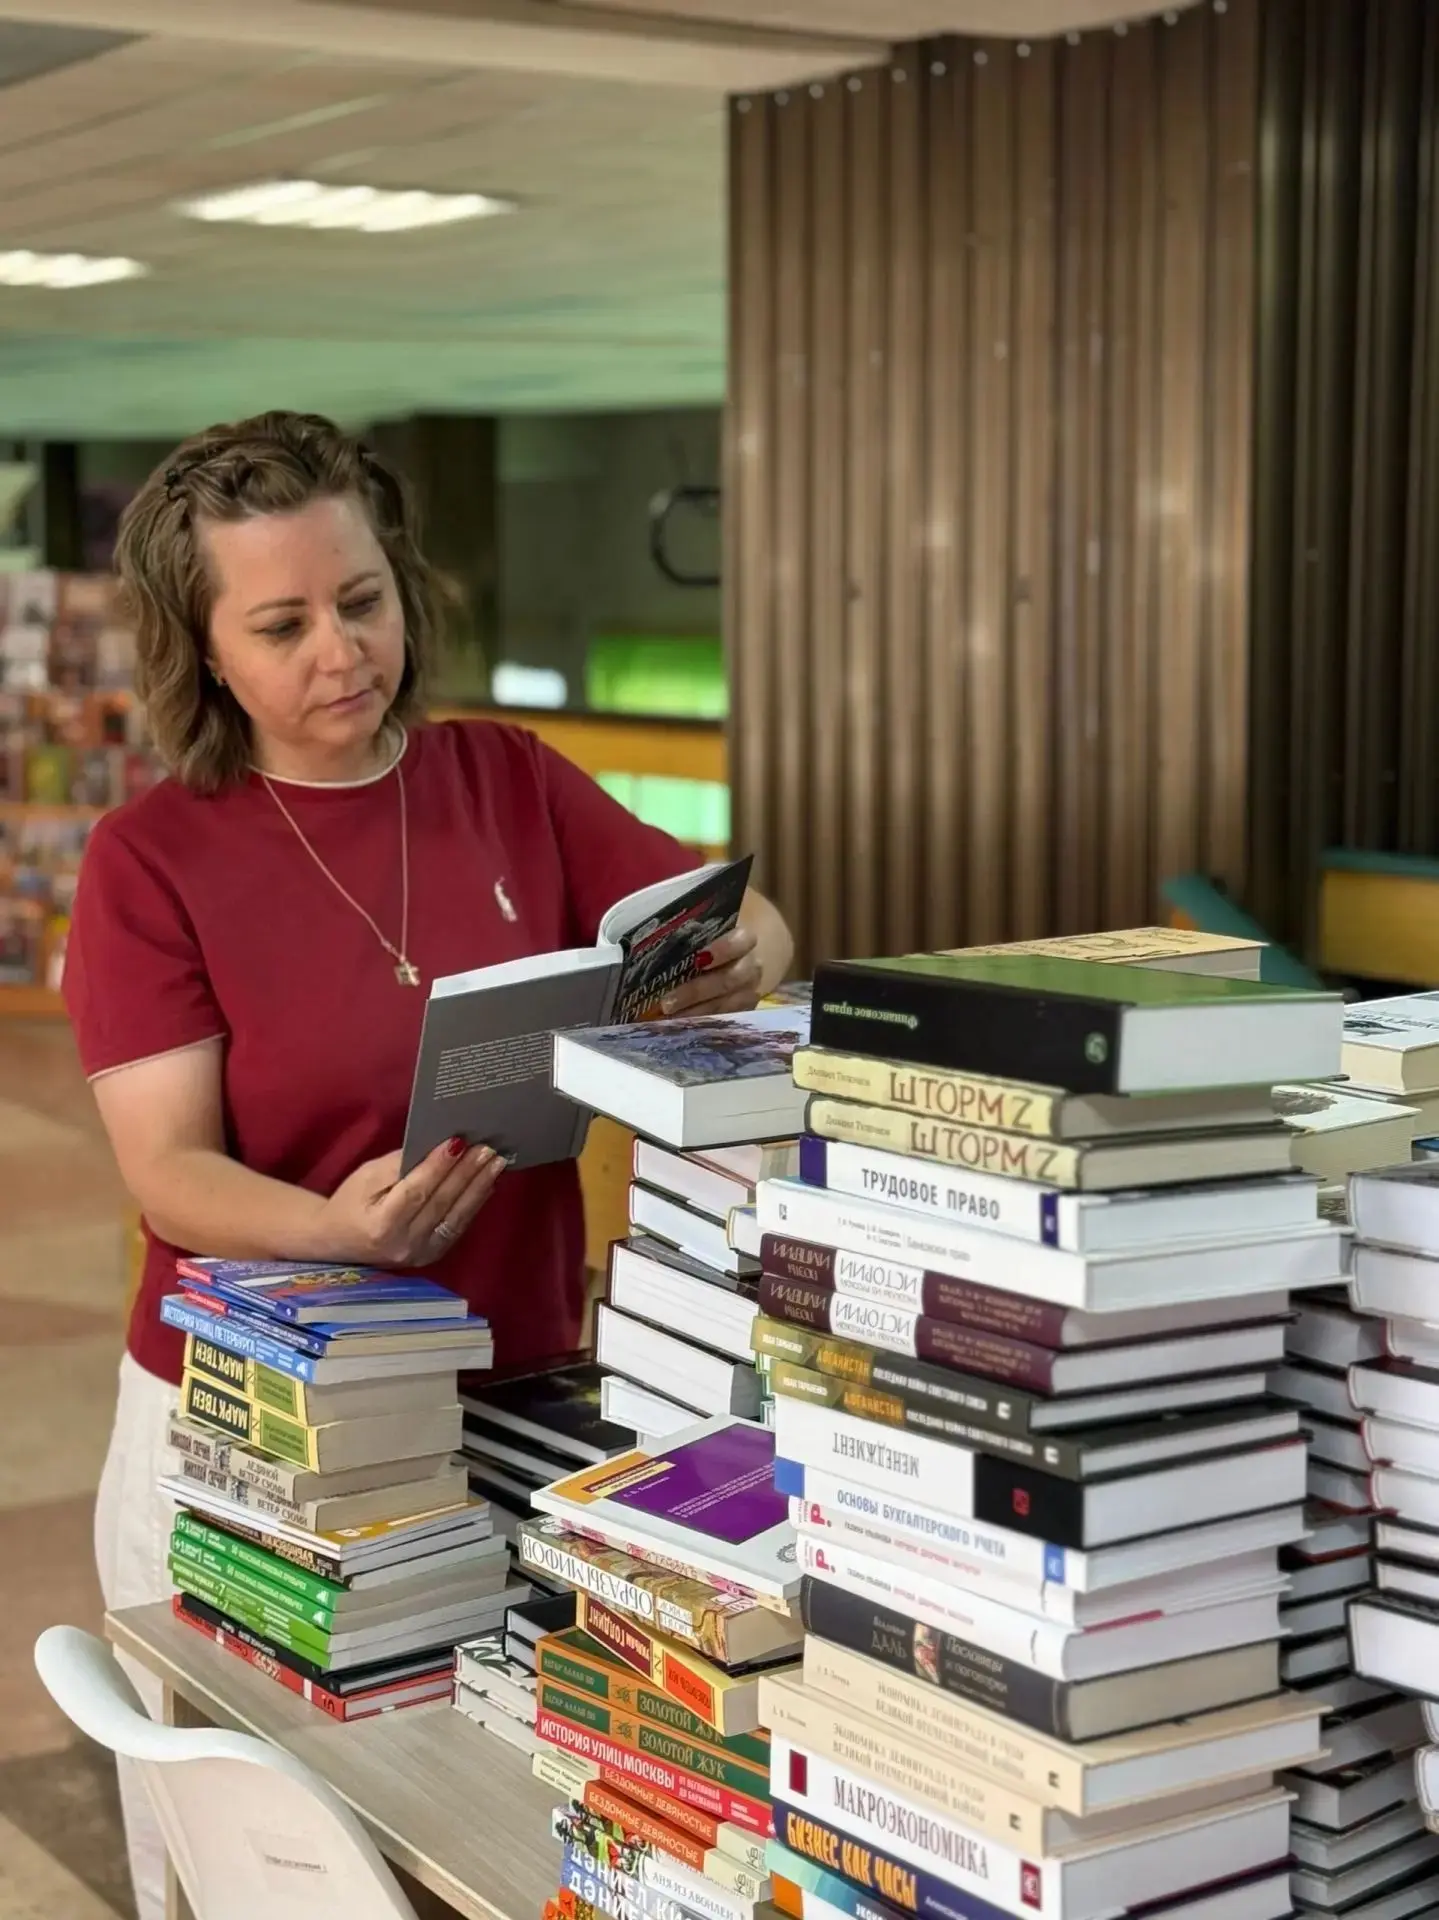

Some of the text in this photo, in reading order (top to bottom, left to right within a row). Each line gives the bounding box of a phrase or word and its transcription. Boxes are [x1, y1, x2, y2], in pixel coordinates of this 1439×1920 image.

[822, 1001, 918, 1030] Финансовое право
[889, 1070, 1033, 1130] ШТОРМ Z
[909, 1121, 1059, 1182] ШТОРМ Z
[861, 1167, 1001, 1222] ТРУДОВОЕ ПРАВО
[773, 1241, 831, 1270] ИМПЕРИИ
[787, 1263, 818, 1282] ПОЭТЫ
[840, 1257, 918, 1295] ИСТОРИИ
[770, 1282, 827, 1311] ИМПЕРИИ
[784, 1304, 816, 1323] ПОЭТЫ
[836, 1300, 911, 1337] ИСТОРИИ
[195, 1340, 218, 1370] ТВЕН
[217, 1354, 244, 1382] МАРК
[192, 1387, 248, 1430] МАРК ТВЕН
[238, 1467, 261, 1485] ВЕТЕР
[246, 1460, 279, 1481] ЛЕДЯНОЙ
[832, 1432, 919, 1479] МЕНЕДЖМЕНТ
[256, 1499, 281, 1518] ВЕТЕР
[837, 1489, 1006, 1558] ОСНОВЫ БУХГАЛТЕРСКОГО УЧЕТА
[522, 1534, 585, 1584] МИФОВ
[587, 1559, 653, 1616] ОБРАЗЫ
[588, 1605, 626, 1647] ГОЛДИНГ
[871, 1630, 908, 1660] ДАЛЬ
[639, 1693, 692, 1731] ЗОЛОТОЙ
[540, 1716, 591, 1754] ИСТОРИЯ
[591, 1739, 623, 1771] УЛИЦ
[623, 1751, 675, 1789] МОСКВЫ
[640, 1730, 726, 1781] ЗОЛОТОЙ ЖУК
[604, 1766, 655, 1805] БЕЗДОМНЫЕ
[654, 1791, 713, 1837] ДЕВЯНОСТЫЕ
[589, 1791, 699, 1864] БЕЗДОМНЫЕ ДЕВЯНОСТЫЕ
[834, 1776, 989, 1880] МАКРОЭКОНОМИКА
[571, 1842, 693, 1920] ДЭНИЕЛ КИ
[786, 1811, 840, 1868] БИЗНЕС
[841, 1838, 873, 1887] КАК
[874, 1857, 919, 1911] ЧАСЫ
[568, 1870, 650, 1920] ДЭНИЕ
[651, 1871, 675, 1889] АНЯ
[673, 1882, 688, 1897] ИЗ
